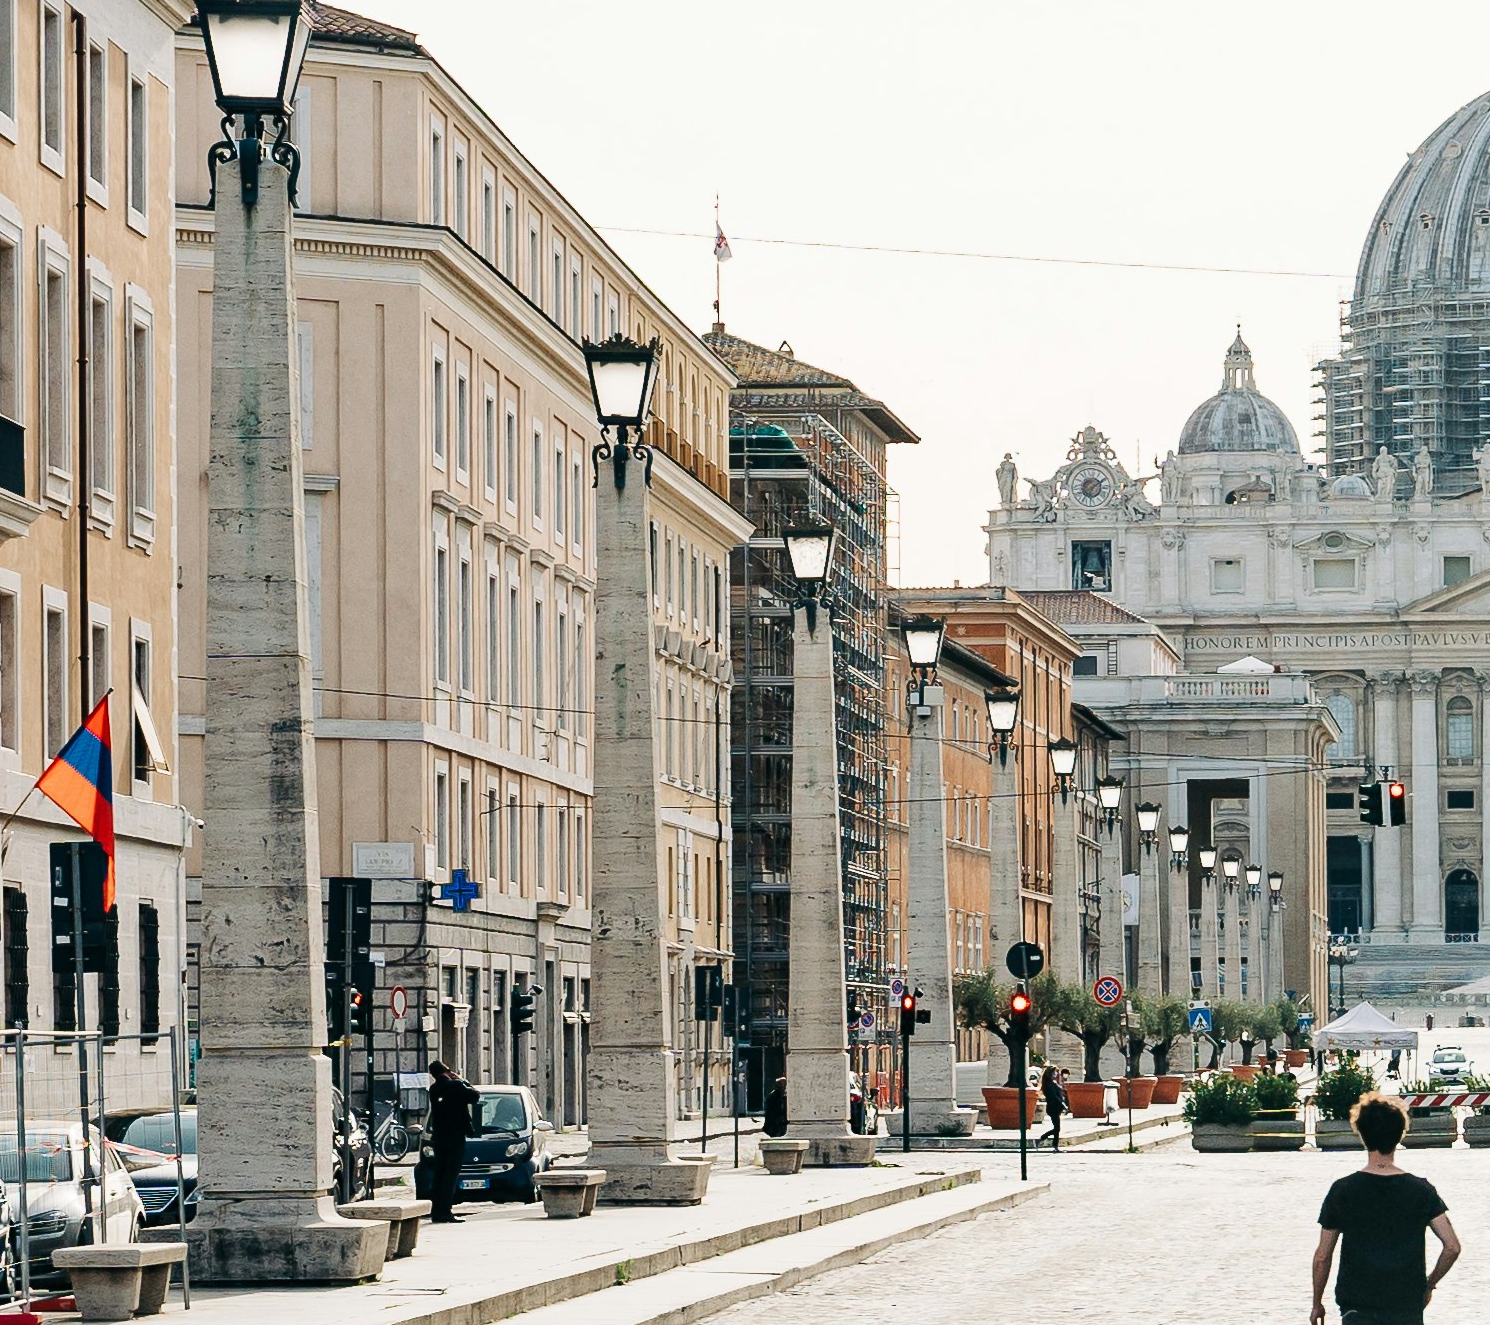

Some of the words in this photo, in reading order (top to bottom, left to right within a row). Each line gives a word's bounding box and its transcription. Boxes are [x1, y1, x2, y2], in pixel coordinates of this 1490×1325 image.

[1184, 636, 1269, 650] HONOREM
[1273, 635, 1356, 648] PRINCIPIS
[1360, 634, 1410, 647] APOST
[1413, 632, 1468, 645] PAVLVS
